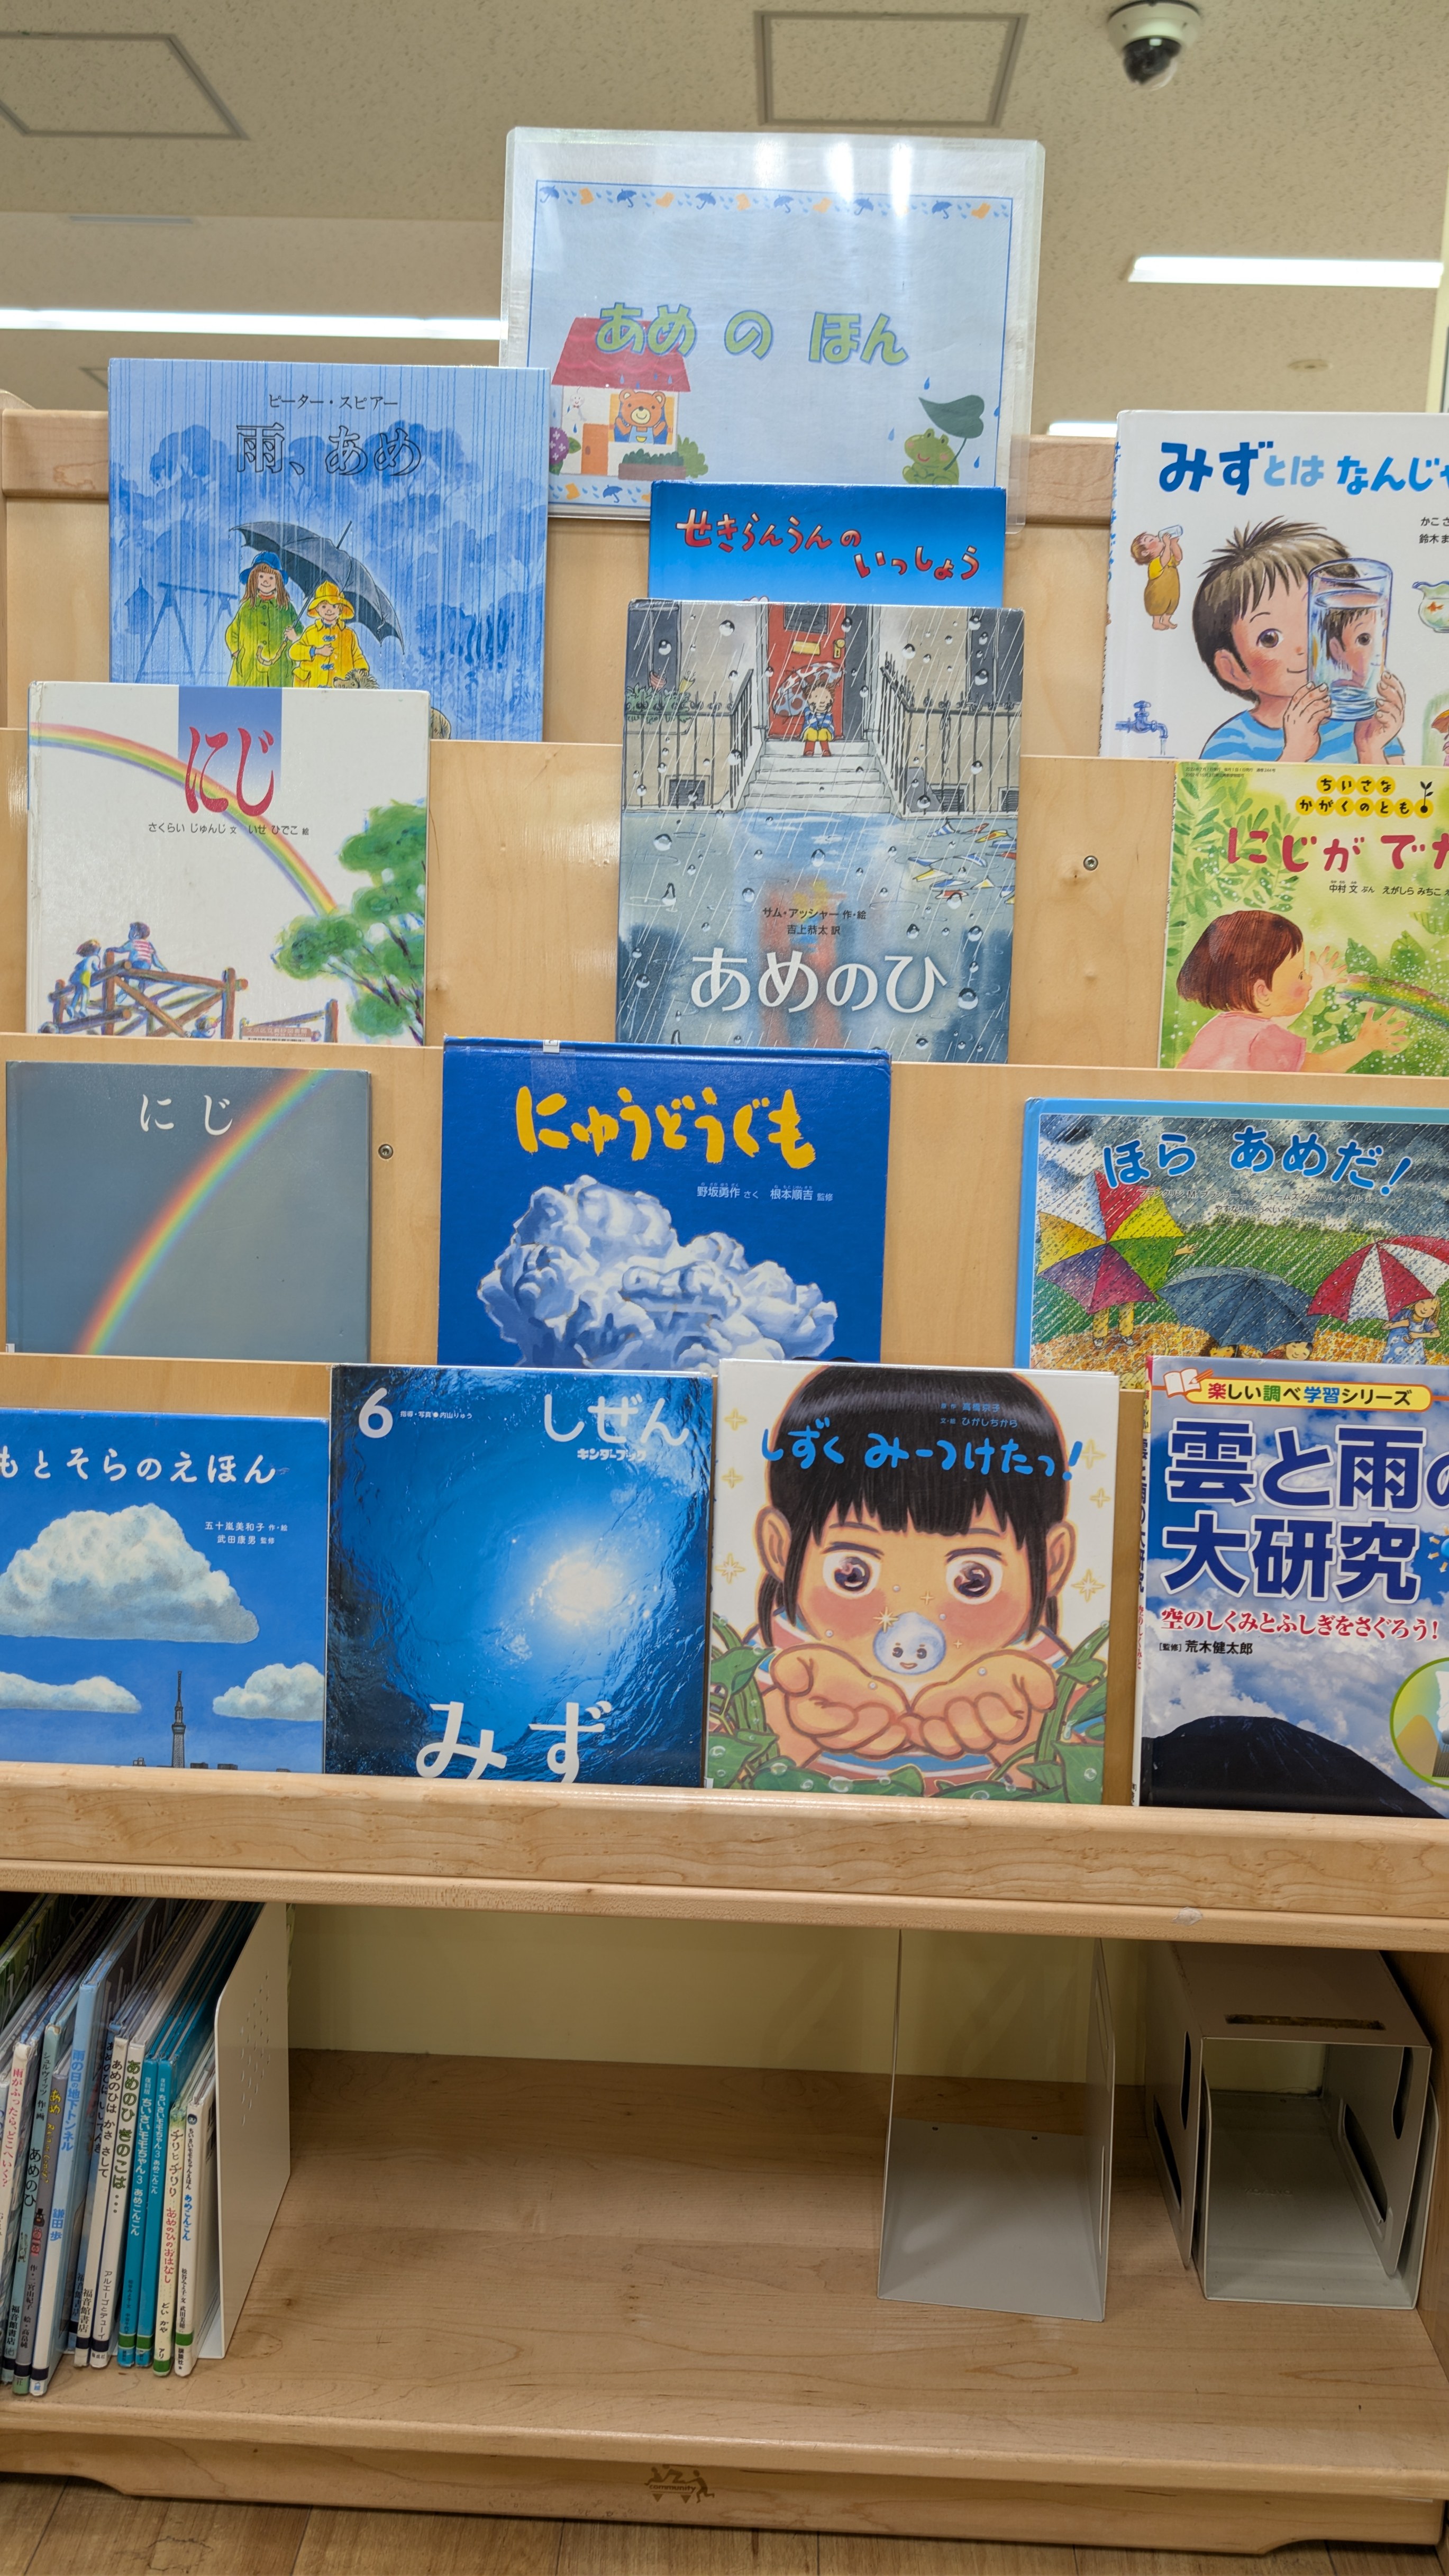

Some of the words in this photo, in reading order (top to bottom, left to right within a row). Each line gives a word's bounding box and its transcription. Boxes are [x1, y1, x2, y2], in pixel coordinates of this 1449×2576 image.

[595, 302, 697, 358] あめ
[724, 310, 774, 360] の
[808, 311, 909, 366] ほん
[269, 393, 398, 410] ピーター・スピアー
[235, 422, 422, 476] 雨、あめ
[854, 545, 980, 580] いっしょう
[185, 726, 274, 817] にじ
[1320, 777, 1392, 793] ちいさな
[148, 822, 185, 833] さくらい
[190, 823, 226, 834] じゅんじ
[249, 825, 267, 834] いせ
[271, 825, 298, 835] ひでこ
[1300, 799, 1411, 815] かがくのとも
[762, 907, 839, 920] サム・アッシャー
[1382, 886, 1414, 895] えがしら
[1417, 887, 1441, 896] みちこ
[787, 924, 828, 935] 吉上恭太
[831, 925, 840, 935] 訳
[690, 947, 949, 1014] あめのひ
[516, 1086, 816, 1169] にゅうどうぐも
[1103, 1131, 1198, 1189] ほら
[744, 1190, 759, 1199] さく
[358, 1387, 393, 1439] 6
[1208, 1382, 1412, 1406] 楽しい調べ学習シリーズ
[543, 1393, 690, 1447] しぜん
[761, 1417, 845, 1469] しずく
[577, 1448, 647, 1461] キンダーブック
[1165, 1418, 1449, 1510] 雲と雨
[1161, 1511, 1420, 1602] 大研究
[1185, 1640, 1253, 1655] 荒木健太郎
[48, 2089, 62, 2115] あめ
[61, 2049, 85, 2152] 雨の日の地下トンネル
[106, 2060, 123, 2114] あめのひは
[24, 2147, 41, 2207] あめのひ
[78, 2288, 93, 2334] 福音館書店
[649, 2484, 696, 2494] community
